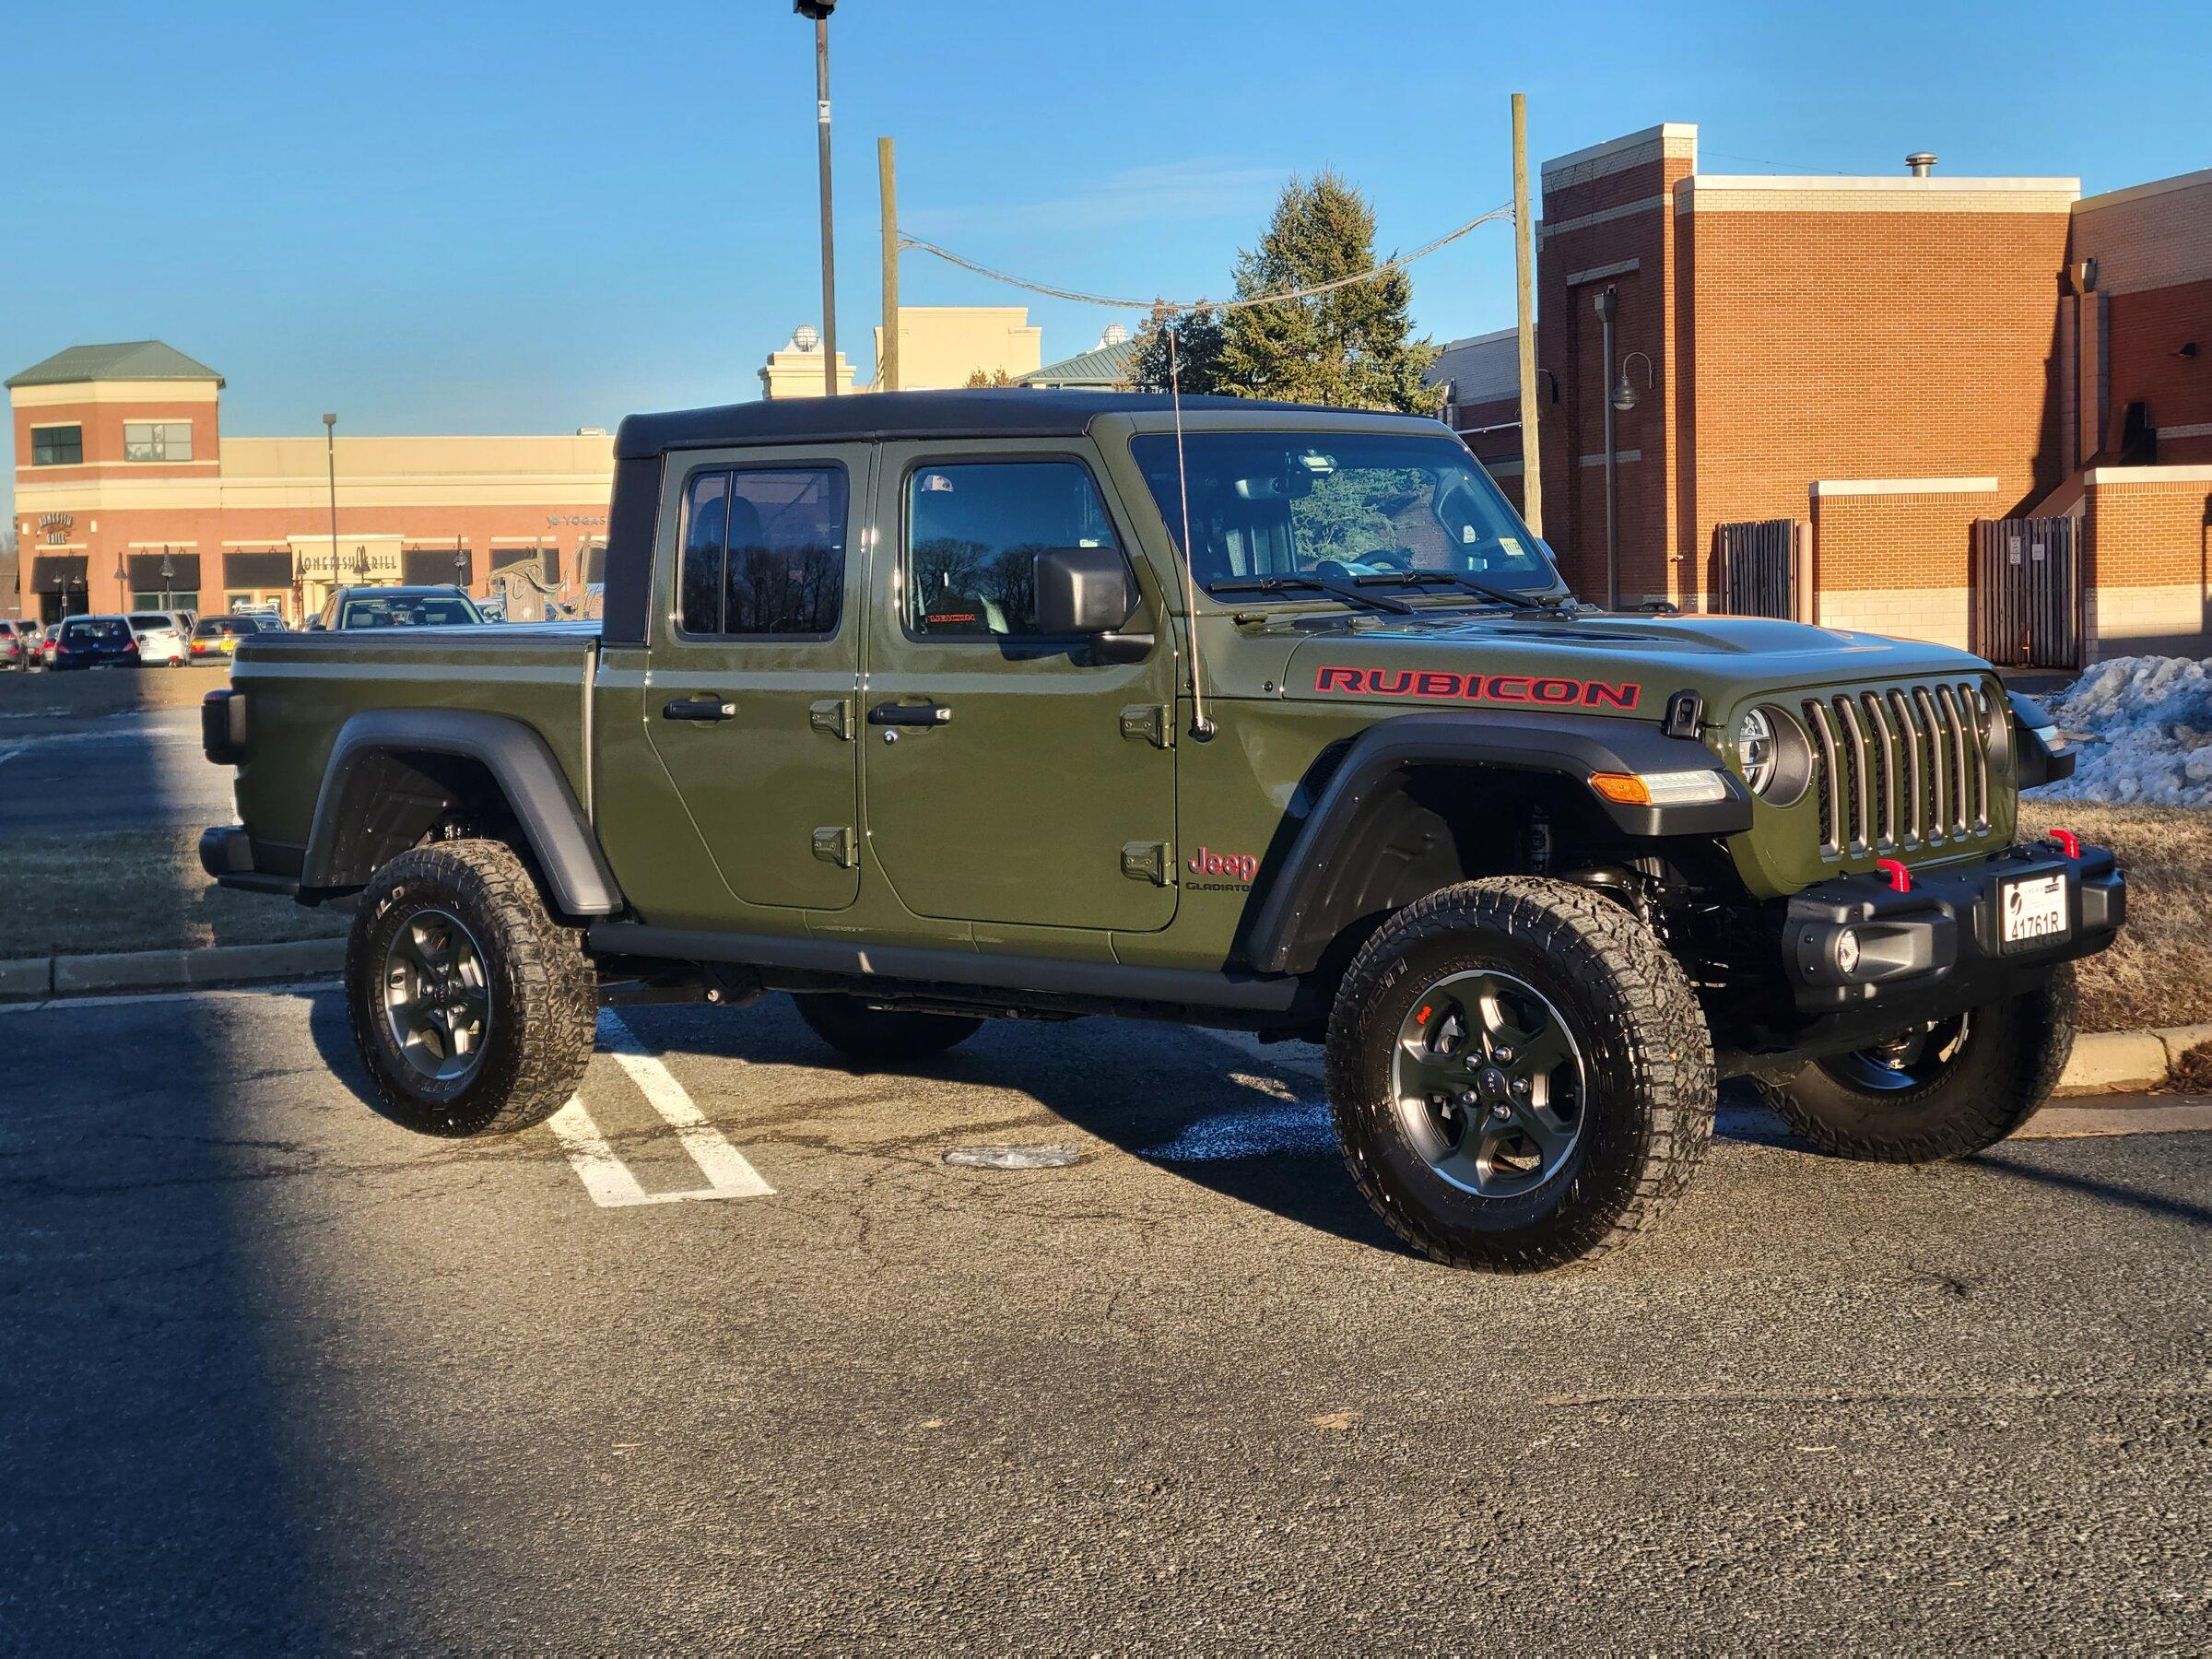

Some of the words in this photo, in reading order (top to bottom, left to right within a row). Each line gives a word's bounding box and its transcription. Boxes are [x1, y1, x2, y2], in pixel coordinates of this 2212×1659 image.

[1315, 665, 1641, 710] RUBICON
[1187, 845, 1259, 881] Jeep
[1185, 882, 1252, 892] GLADIATO
[2011, 911, 2059, 939] 41761R
